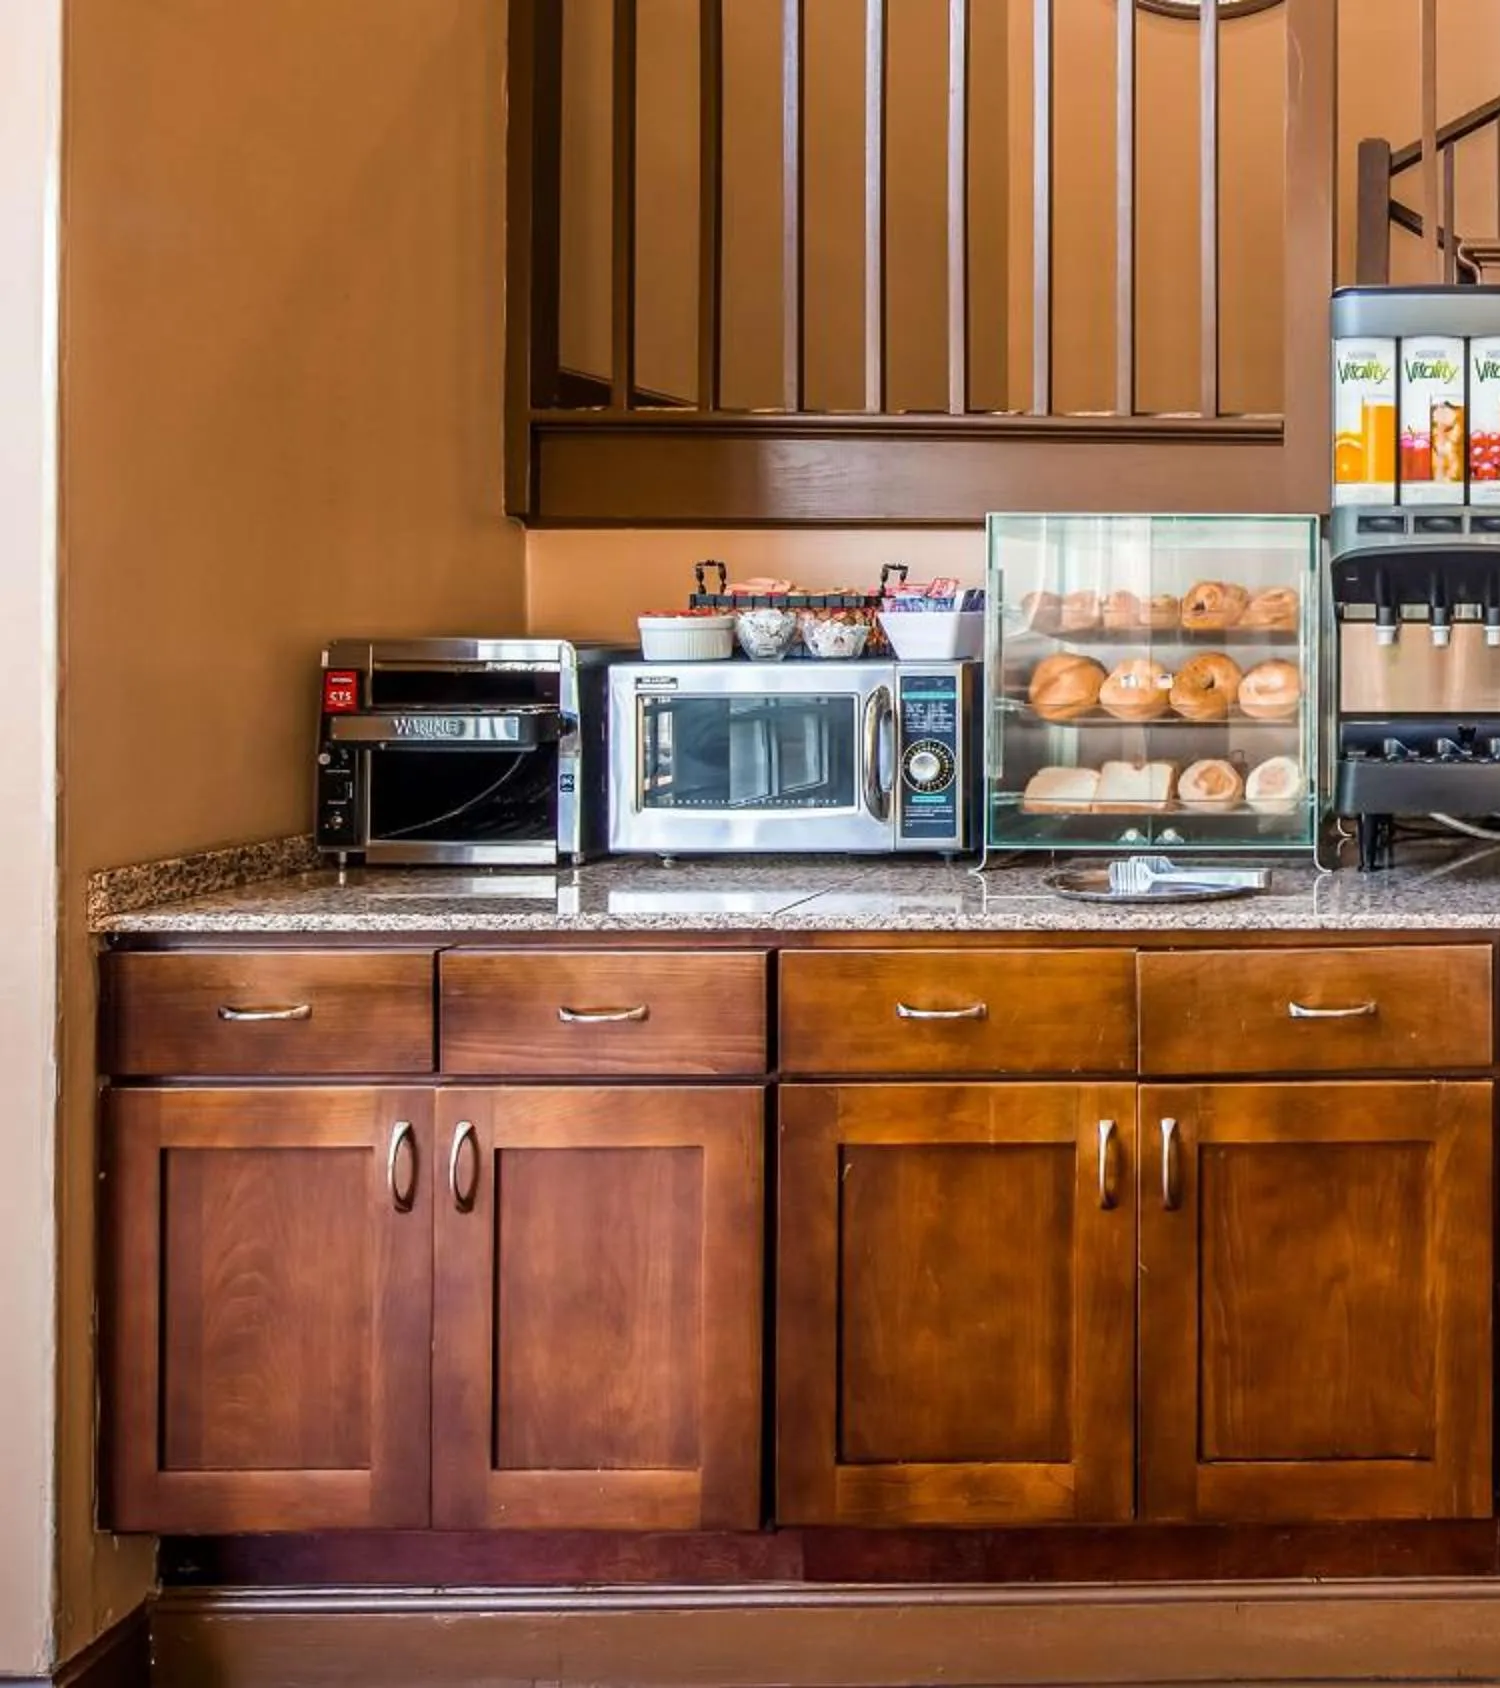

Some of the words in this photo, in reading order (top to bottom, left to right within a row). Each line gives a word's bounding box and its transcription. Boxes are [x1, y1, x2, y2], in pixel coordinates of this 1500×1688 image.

[1338, 358, 1390, 384] Vitality
[1405, 358, 1458, 384] Vitality
[330, 691, 352, 701] CTS
